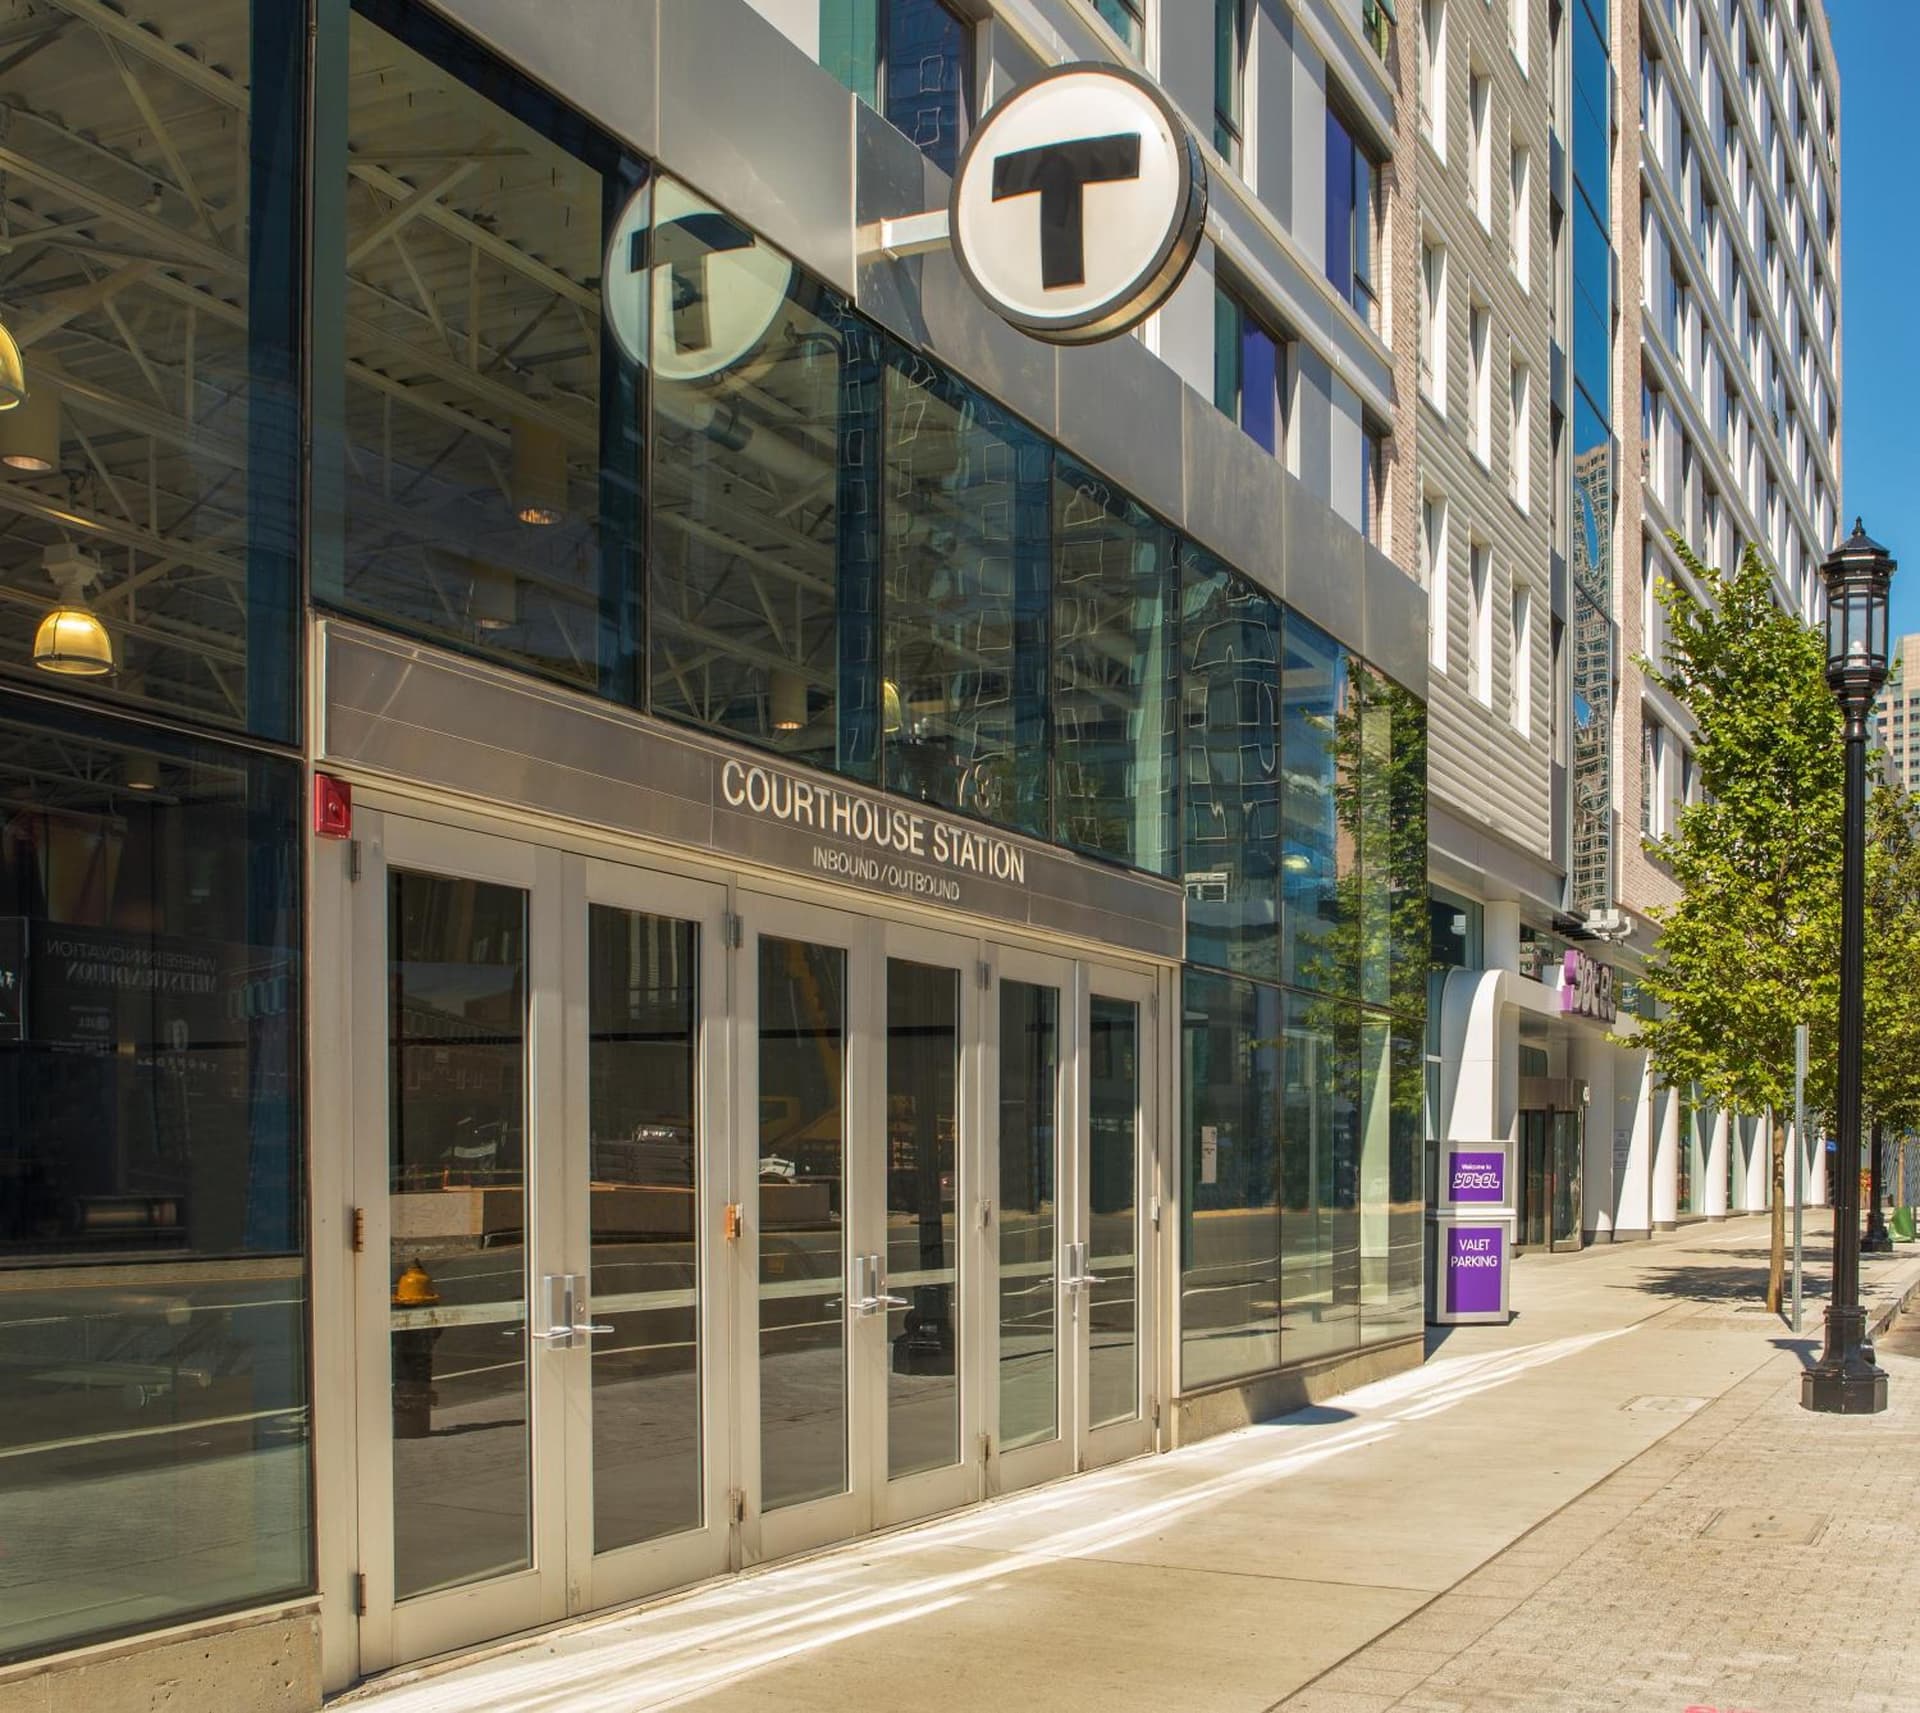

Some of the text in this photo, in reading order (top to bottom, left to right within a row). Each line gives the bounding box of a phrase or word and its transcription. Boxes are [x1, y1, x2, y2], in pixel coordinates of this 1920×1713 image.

[991, 132, 1141, 292] T
[721, 759, 925, 857] COURTHOUSE
[932, 823, 1026, 884] STATION
[1450, 1255, 1498, 1268] PARKING
[1459, 1238, 1491, 1251] VALET
